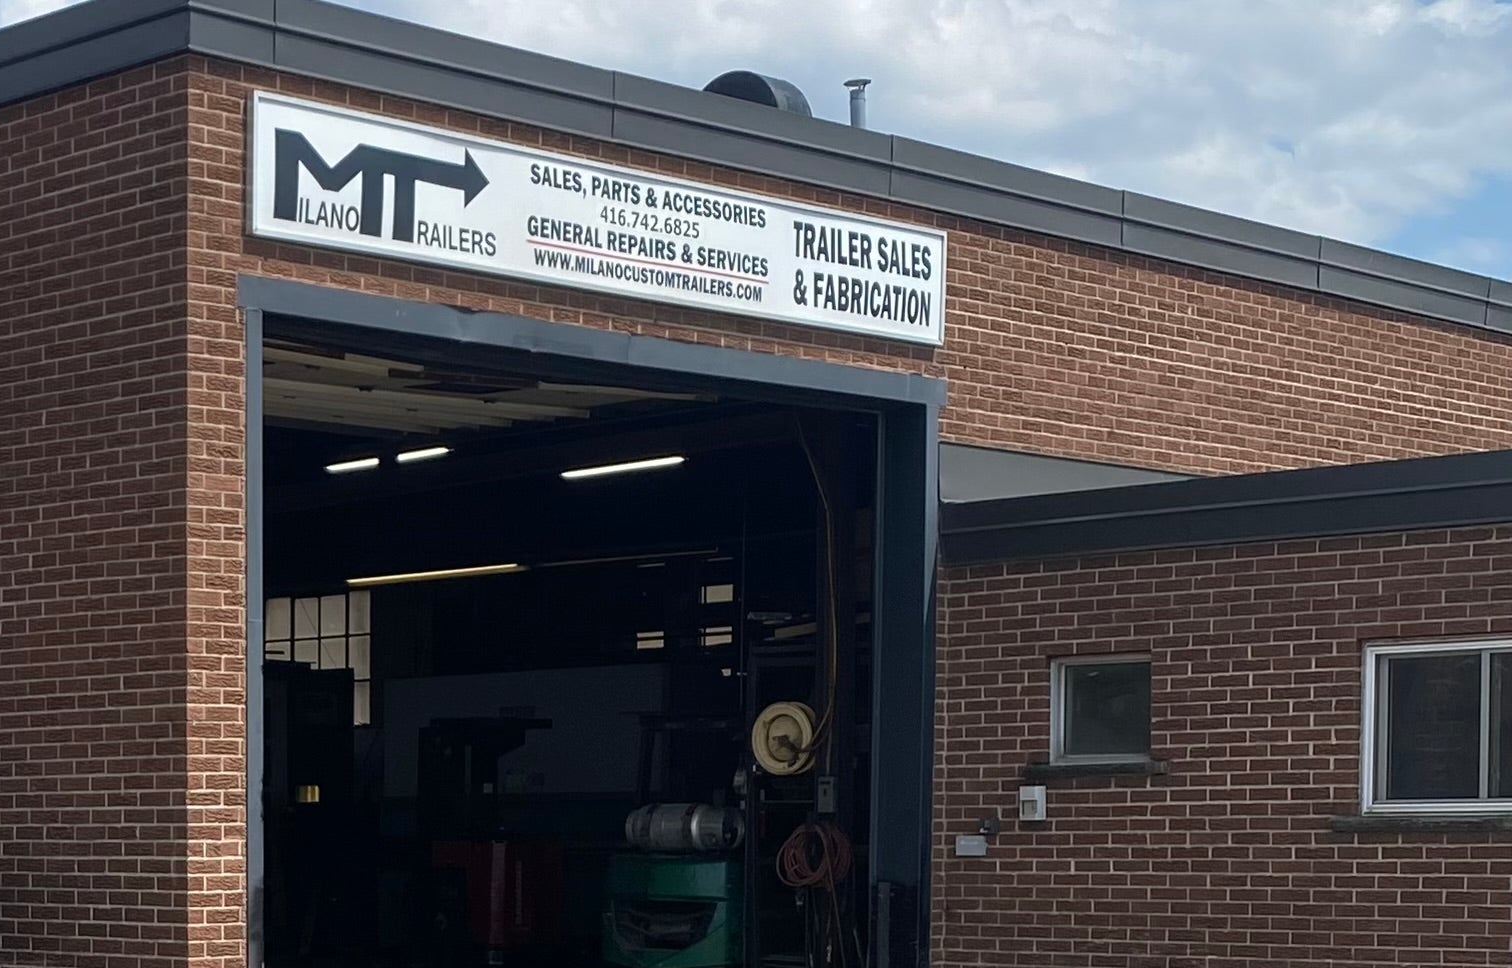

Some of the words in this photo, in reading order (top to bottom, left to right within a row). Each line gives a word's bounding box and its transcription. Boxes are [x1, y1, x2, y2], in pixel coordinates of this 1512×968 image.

[530, 163, 586, 198] SALES,
[591, 176, 641, 205] PARTS
[646, 188, 658, 209] &
[662, 190, 767, 228] ACCESSORIES
[600, 204, 700, 239] 416.742.6825
[527, 214, 603, 250] GENERAL
[607, 229, 676, 262] REPAIRS
[681, 244, 693, 264] &
[697, 249, 769, 278] SERVICES
[534, 248, 762, 303] WWW.MILANOCUSTOMTRAILERS.COM
[793, 220, 872, 270] TRAILER
[877, 238, 932, 281] SALES
[794, 269, 807, 306] &
[813, 272, 931, 328] FABRICATION
